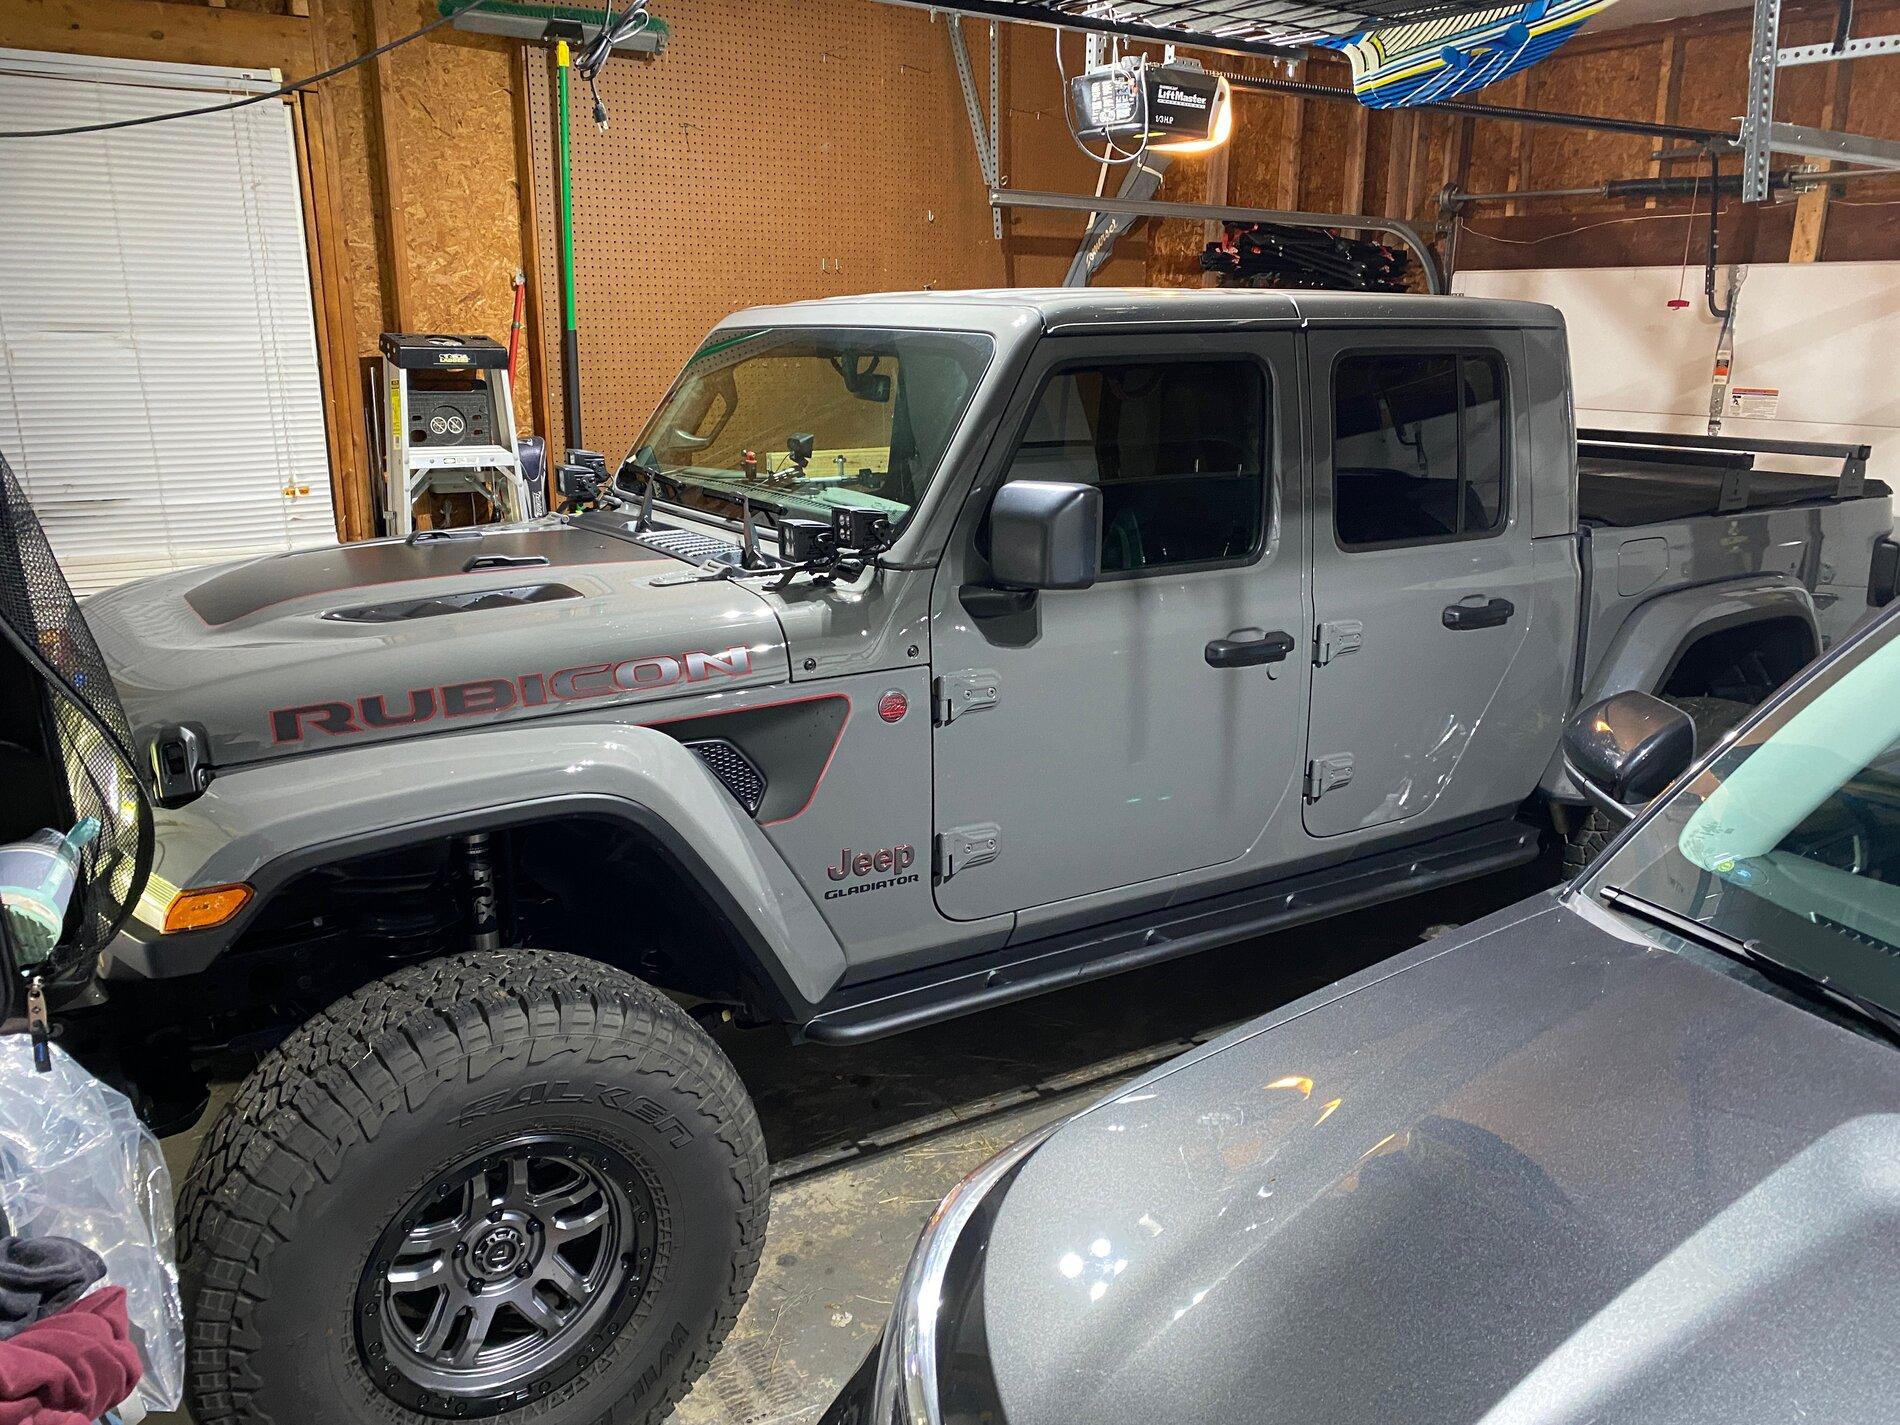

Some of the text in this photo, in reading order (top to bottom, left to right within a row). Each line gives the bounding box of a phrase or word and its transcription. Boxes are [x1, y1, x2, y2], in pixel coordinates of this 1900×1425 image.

[268, 645, 753, 745] RUBICON
[824, 874, 919, 900] GLADIATOR
[827, 843, 915, 881] Jeep
[447, 1080, 694, 1149] FALKEN
